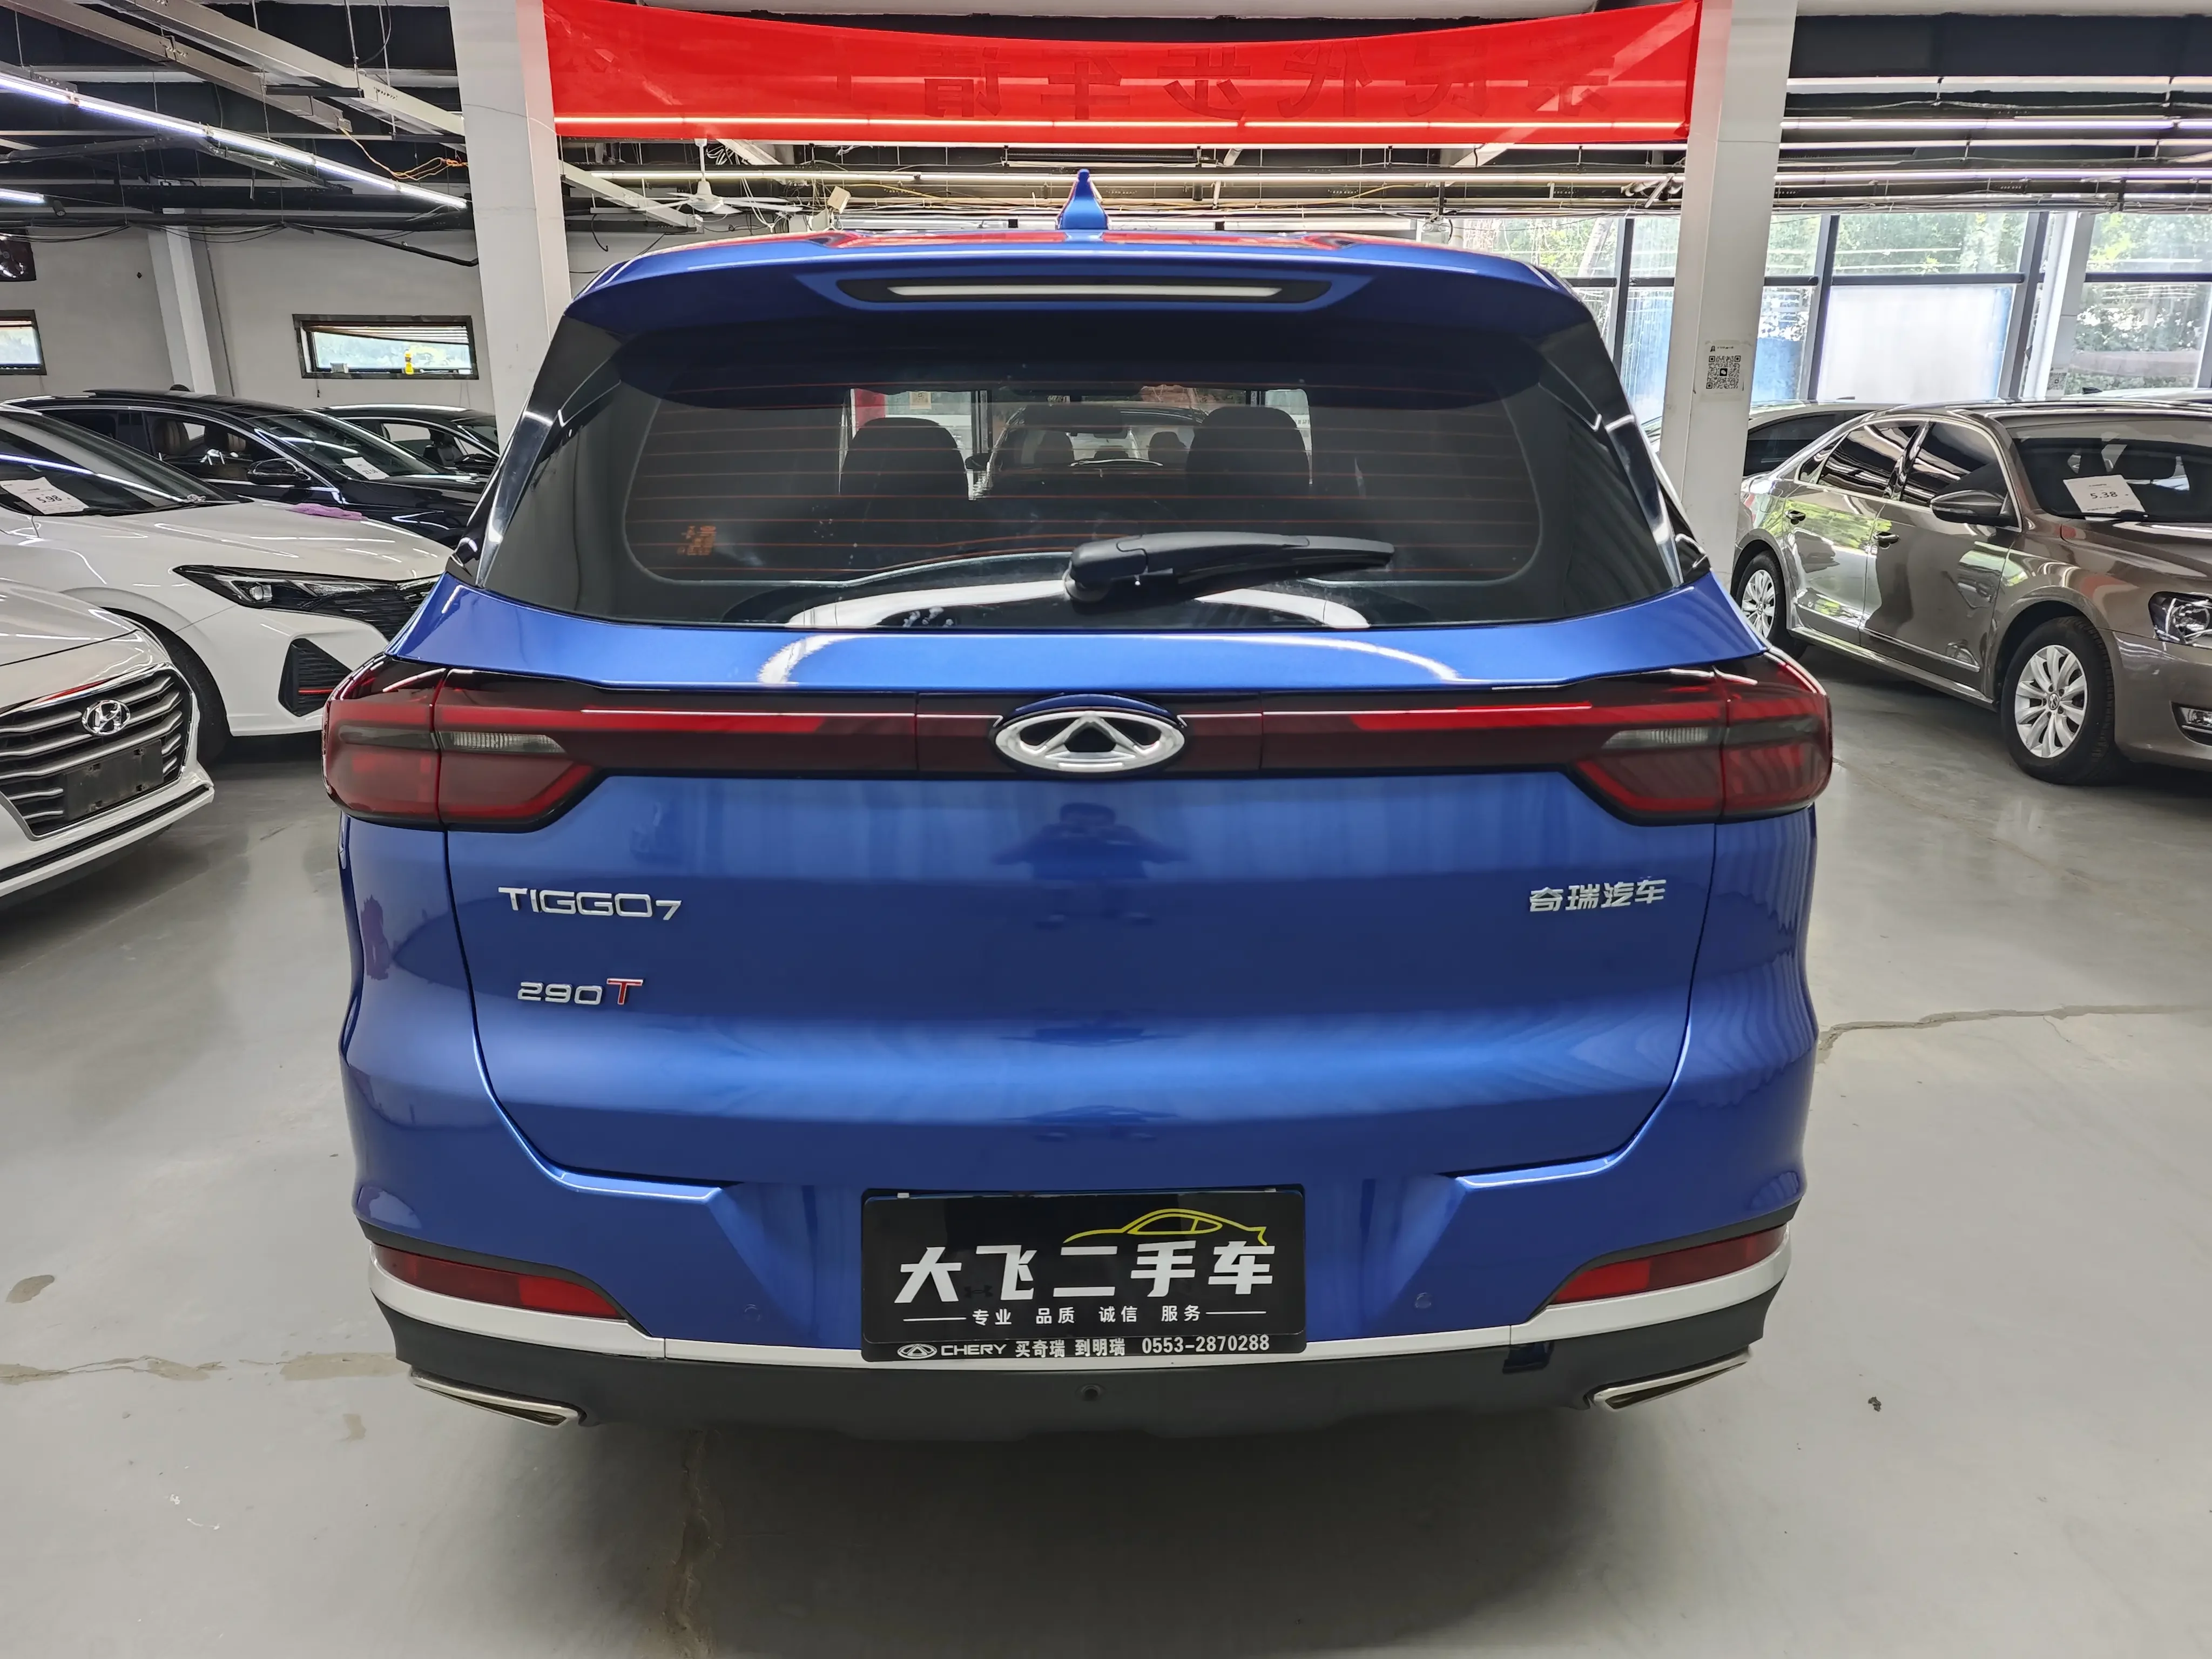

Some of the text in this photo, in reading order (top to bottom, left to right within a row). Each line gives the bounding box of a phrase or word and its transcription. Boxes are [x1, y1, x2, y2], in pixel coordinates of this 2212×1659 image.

[36, 495, 63, 503] 5.98
[2089, 491, 2118, 500] 5.38
[1529, 879, 1667, 913] 奇瑞汽车
[517, 977, 644, 1006] 290T
[894, 1240, 1276, 1304] 大飞二手车
[972, 1303, 1201, 1326] 专业 品质 诚信 服务
[941, 1334, 1270, 1358] CHERY 买奇瑞 到明瑞 0553-2870288
